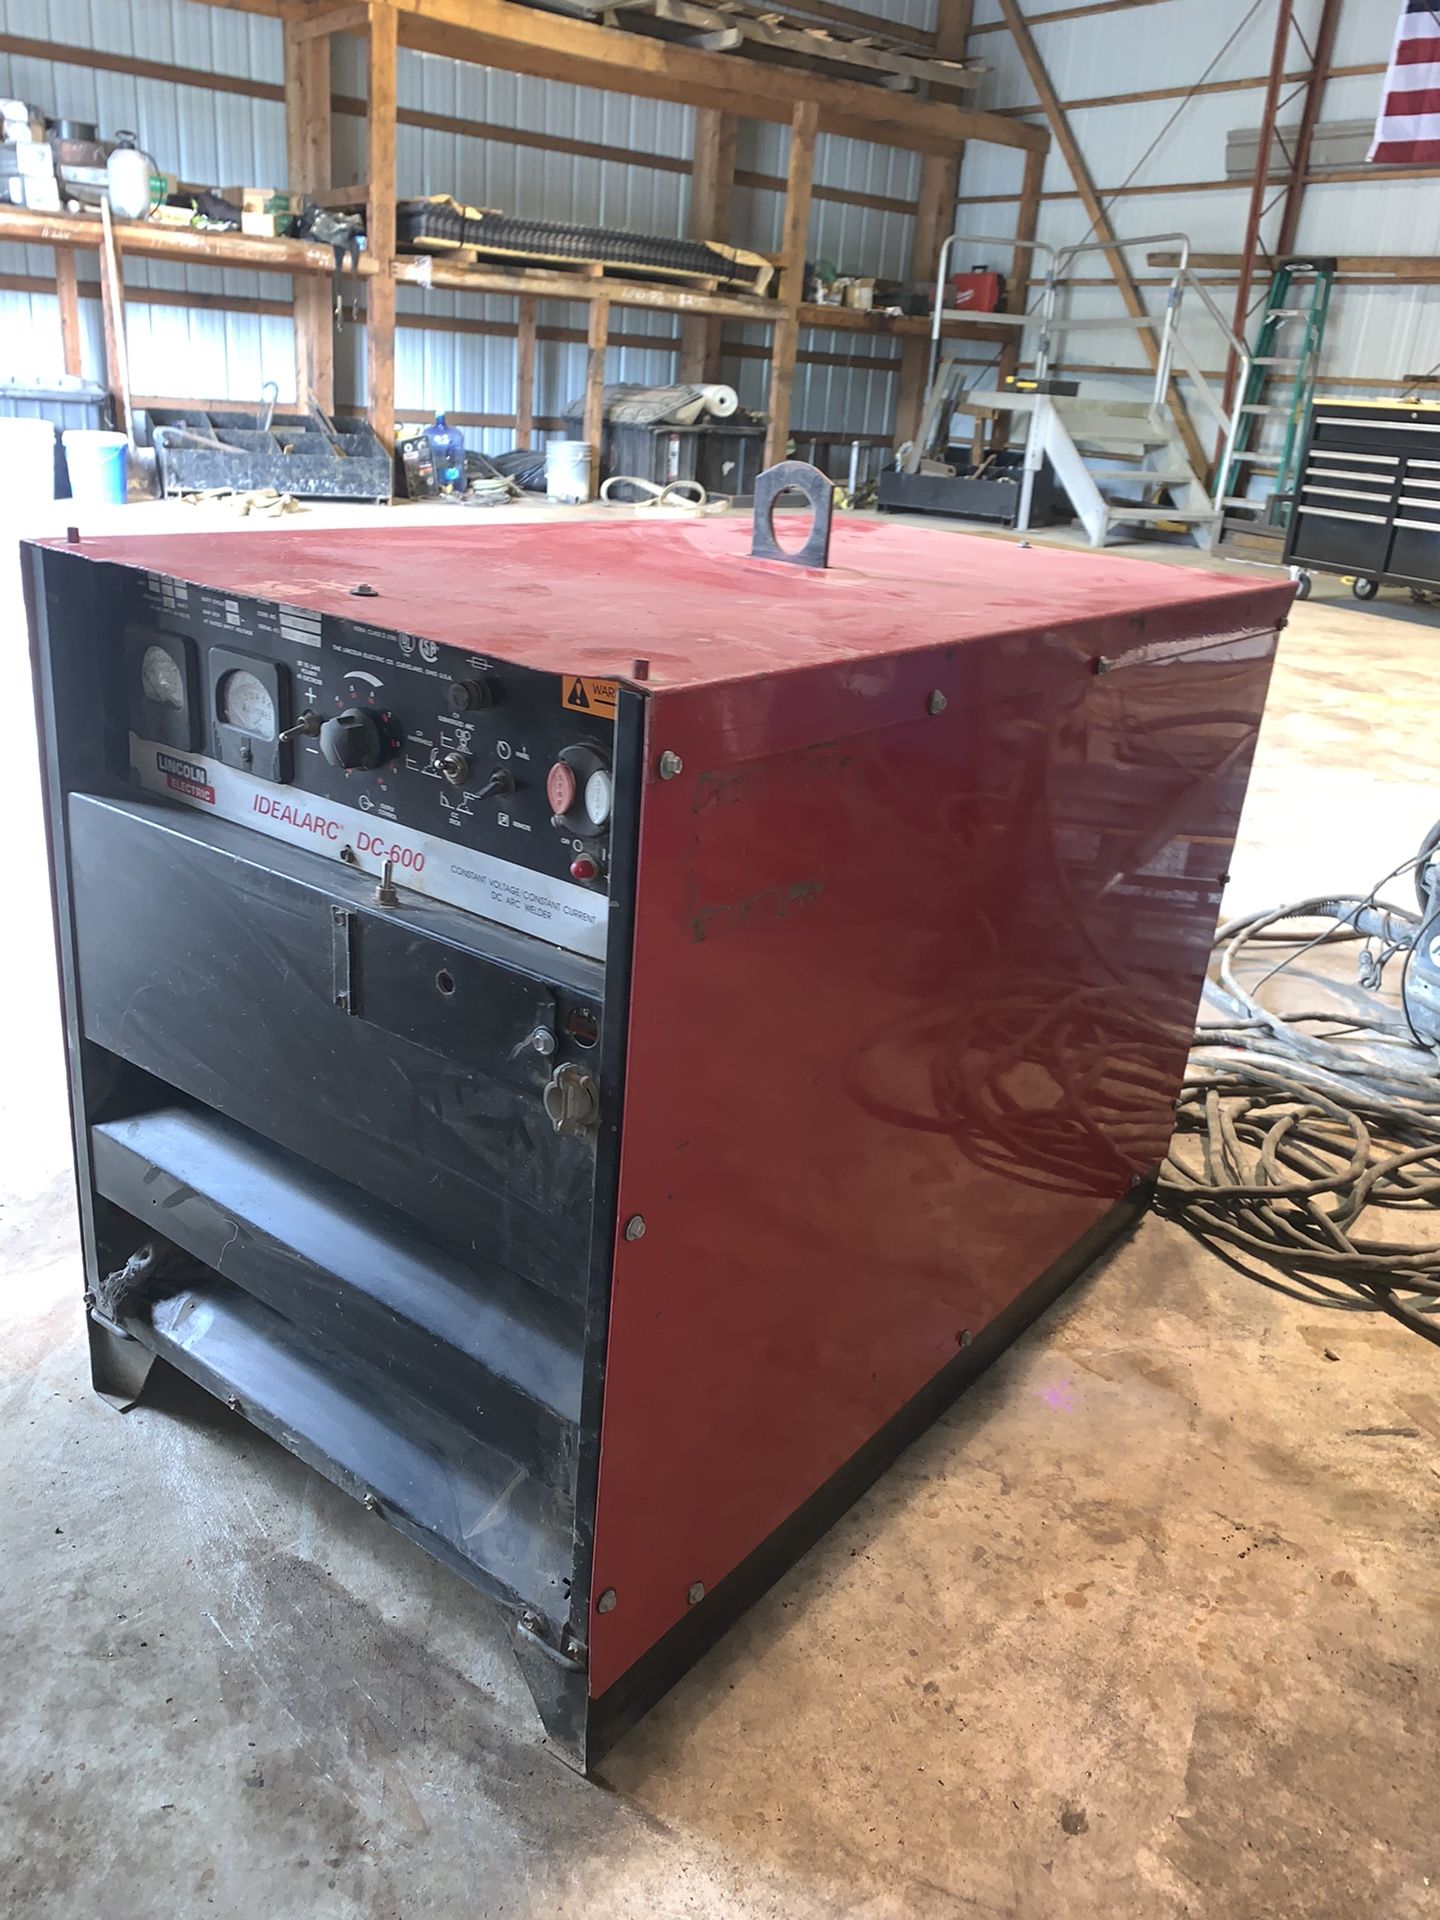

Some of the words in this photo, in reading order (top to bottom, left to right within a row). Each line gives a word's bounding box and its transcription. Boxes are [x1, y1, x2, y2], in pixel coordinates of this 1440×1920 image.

[592, 683, 616, 699] WAR
[159, 756, 206, 784] LINCOLN
[171, 777, 212, 801] ELECTRIC
[253, 793, 340, 840] IDEALARC
[356, 831, 426, 872] DC-600
[450, 864, 487, 885] CONSTANT
[562, 905, 597, 924] CURRENT
[491, 890, 502, 903] DC
[506, 897, 521, 909] ARC
[524, 903, 553, 921] WELDER
